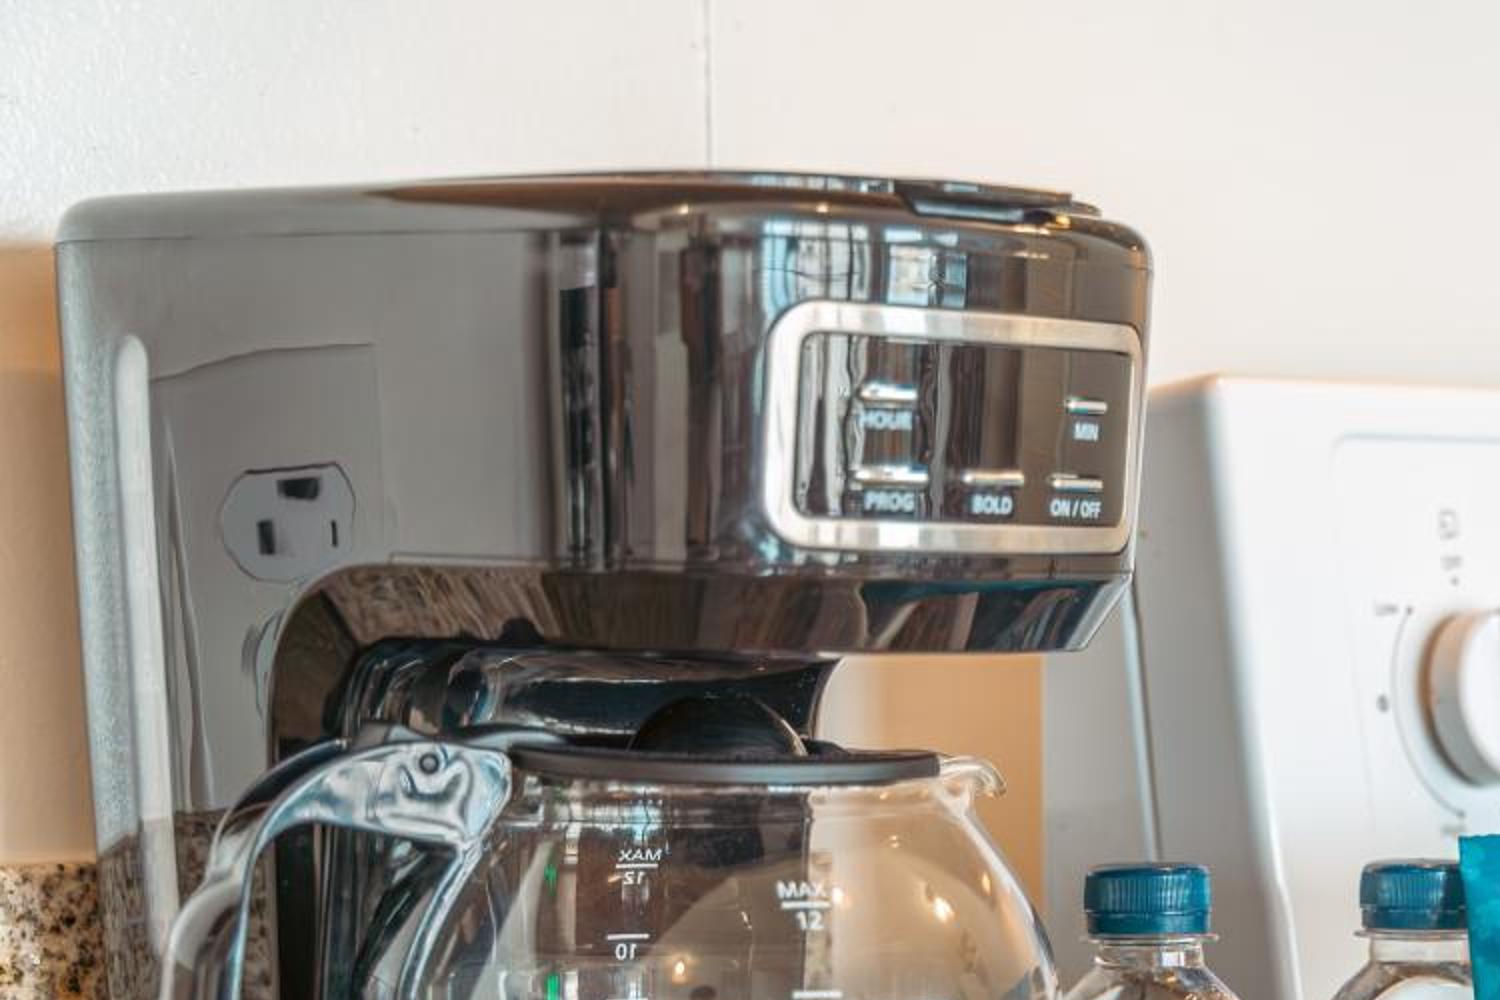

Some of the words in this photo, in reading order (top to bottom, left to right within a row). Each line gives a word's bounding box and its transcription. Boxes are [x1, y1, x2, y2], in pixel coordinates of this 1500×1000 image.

[857, 410, 912, 430] HOUR
[1074, 422, 1099, 441] MIN
[864, 491, 915, 512] PROG
[972, 494, 1013, 514] BOLD
[777, 881, 826, 898] MAX
[796, 911, 824, 930] 12
